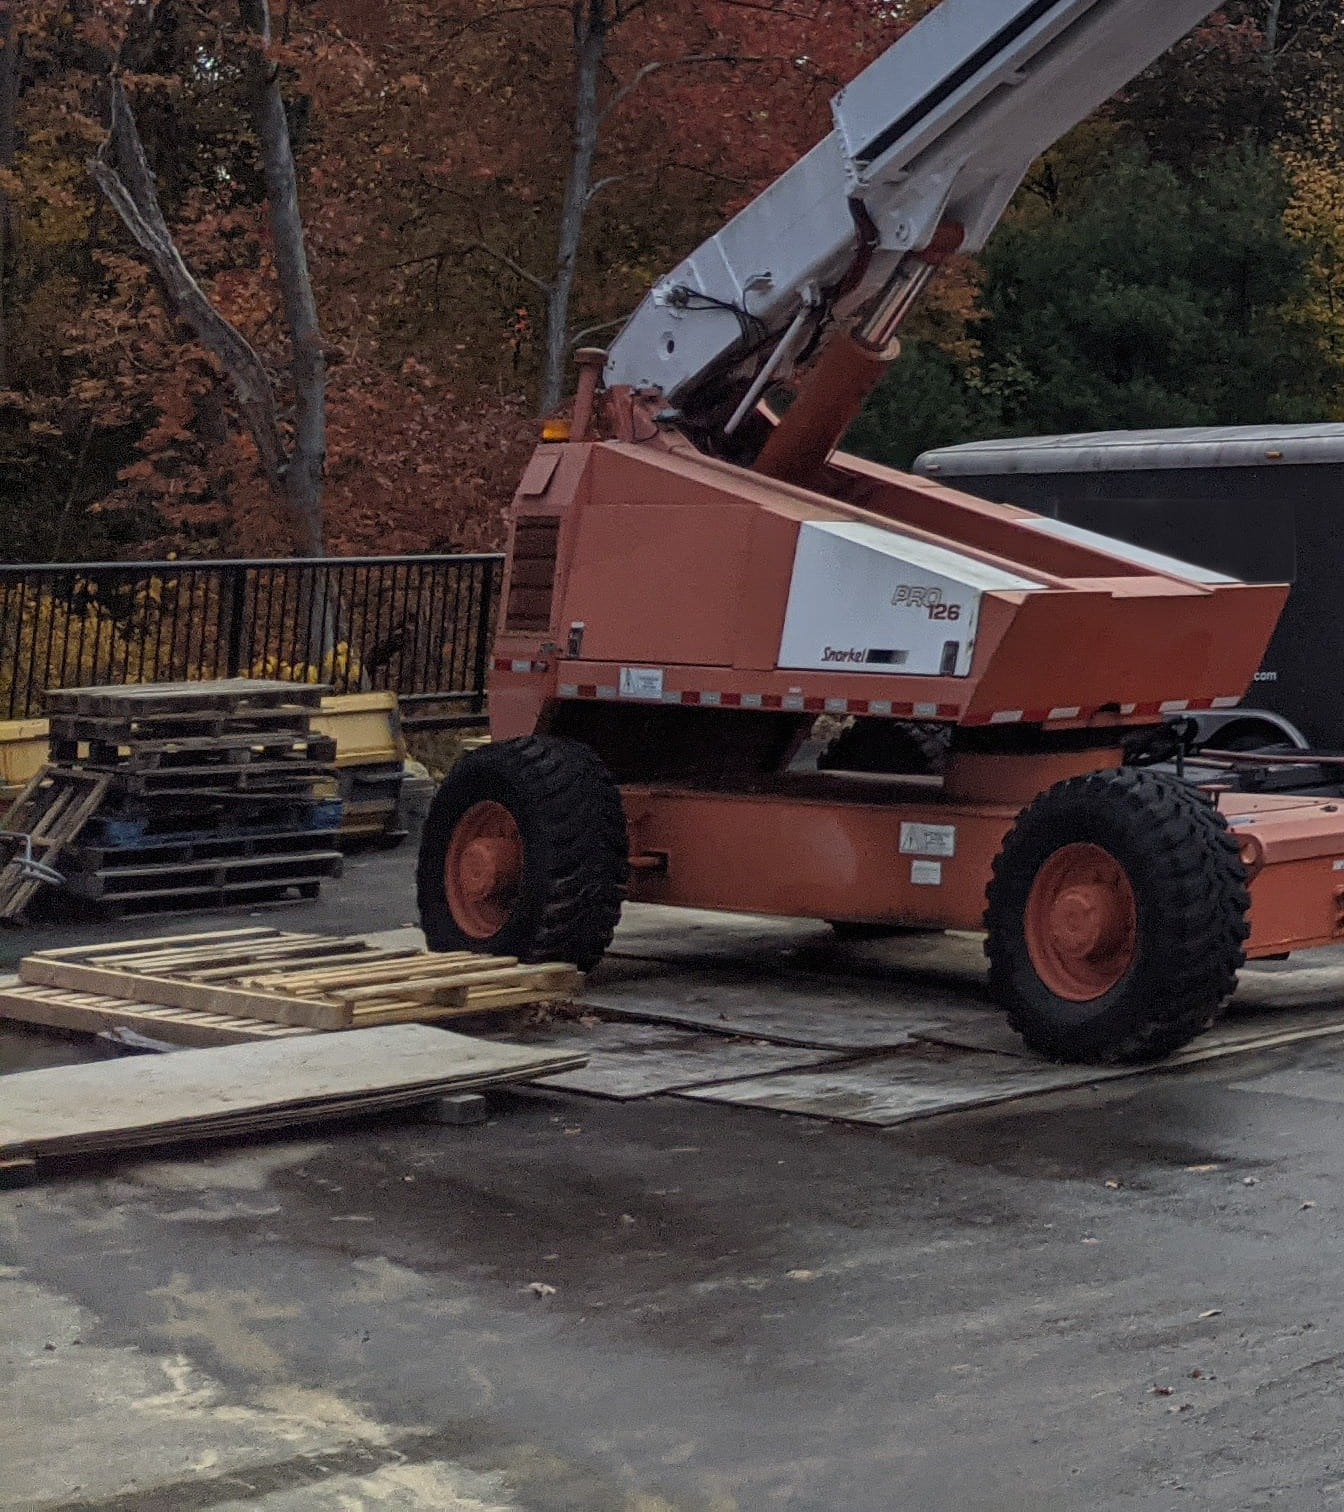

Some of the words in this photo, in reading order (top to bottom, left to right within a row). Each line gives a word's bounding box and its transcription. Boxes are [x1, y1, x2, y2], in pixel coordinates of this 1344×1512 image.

[891, 584, 942, 608] PRO
[927, 603, 961, 621] 126
[820, 646, 868, 663] Snorkel
